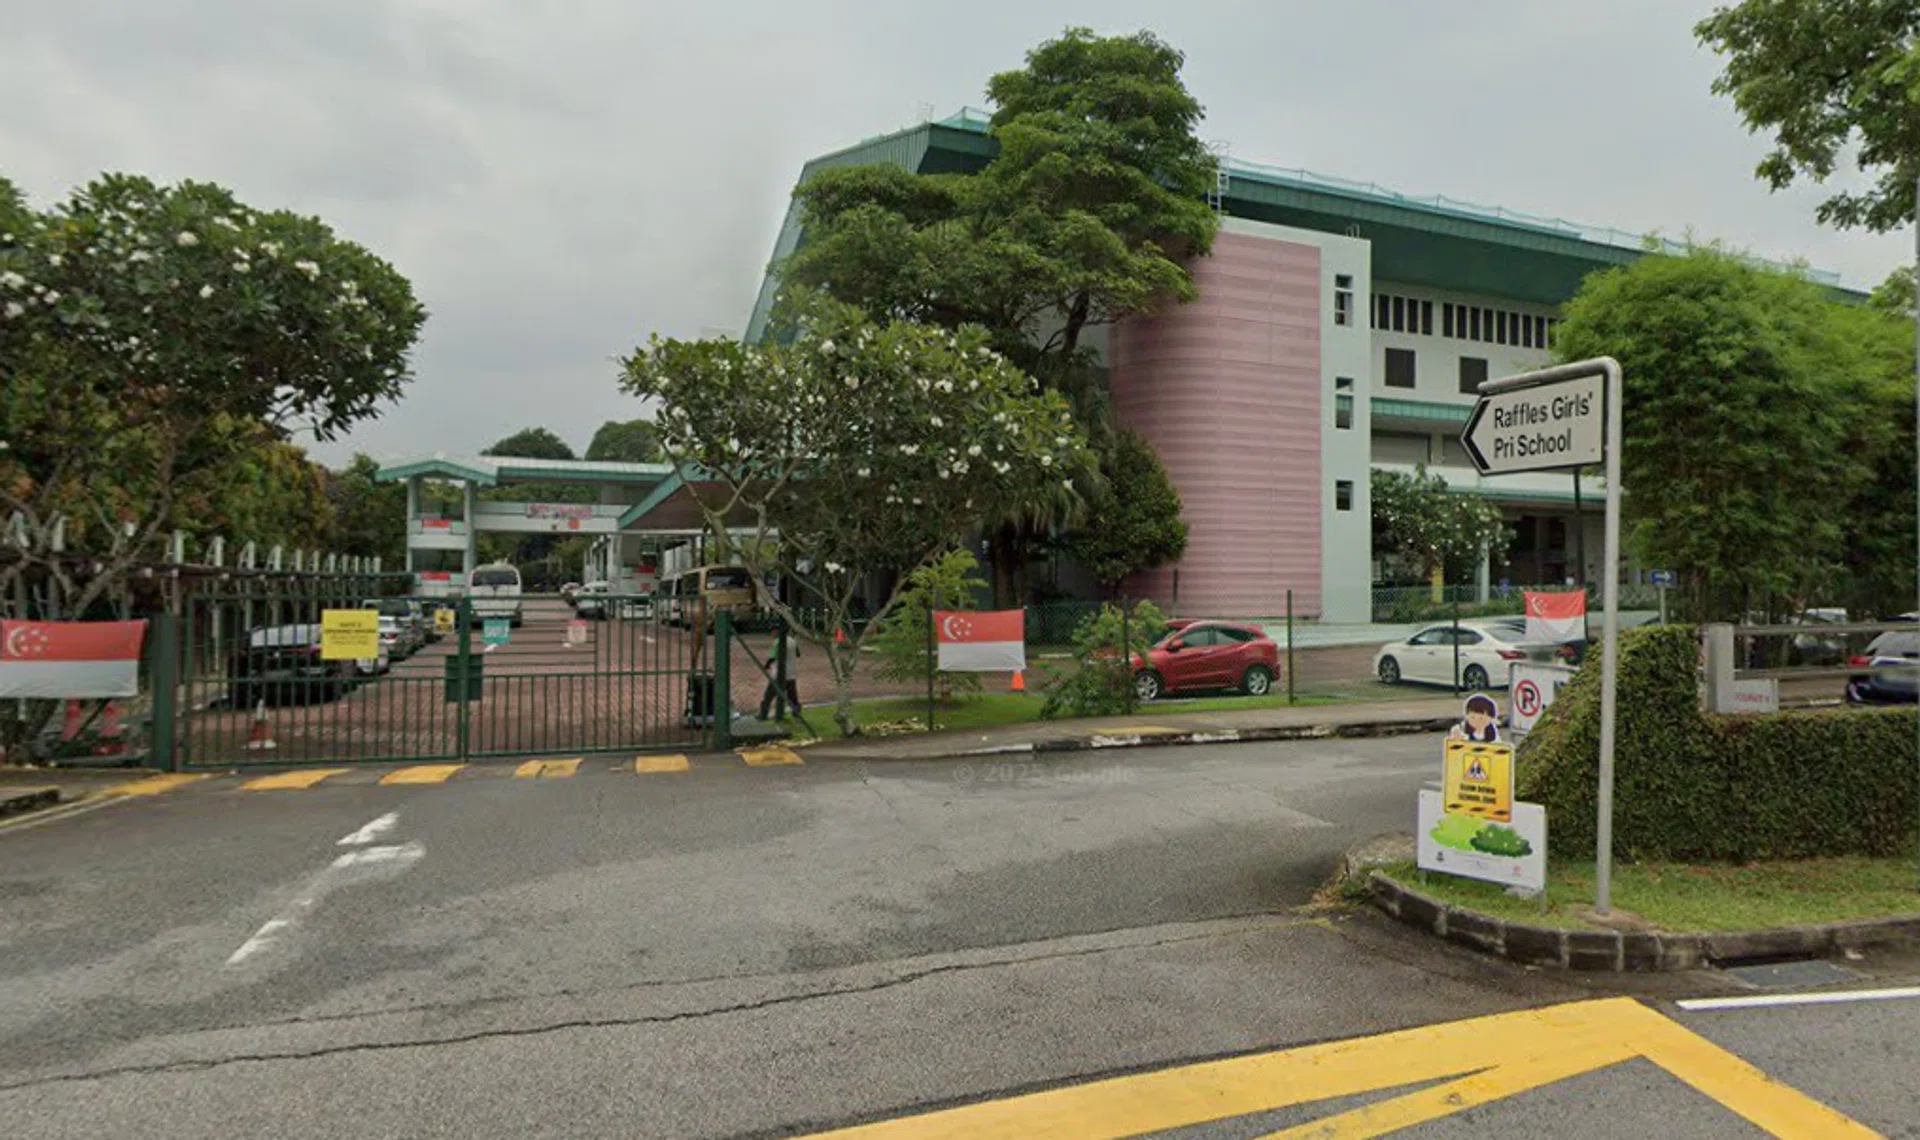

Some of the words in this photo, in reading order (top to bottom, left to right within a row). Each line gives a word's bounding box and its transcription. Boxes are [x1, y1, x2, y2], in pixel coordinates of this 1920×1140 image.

[1494, 404, 1548, 429] Raffles
[1553, 392, 1592, 420] Girls'
[1494, 437, 1514, 458] Pri
[1517, 429, 1571, 456] School
